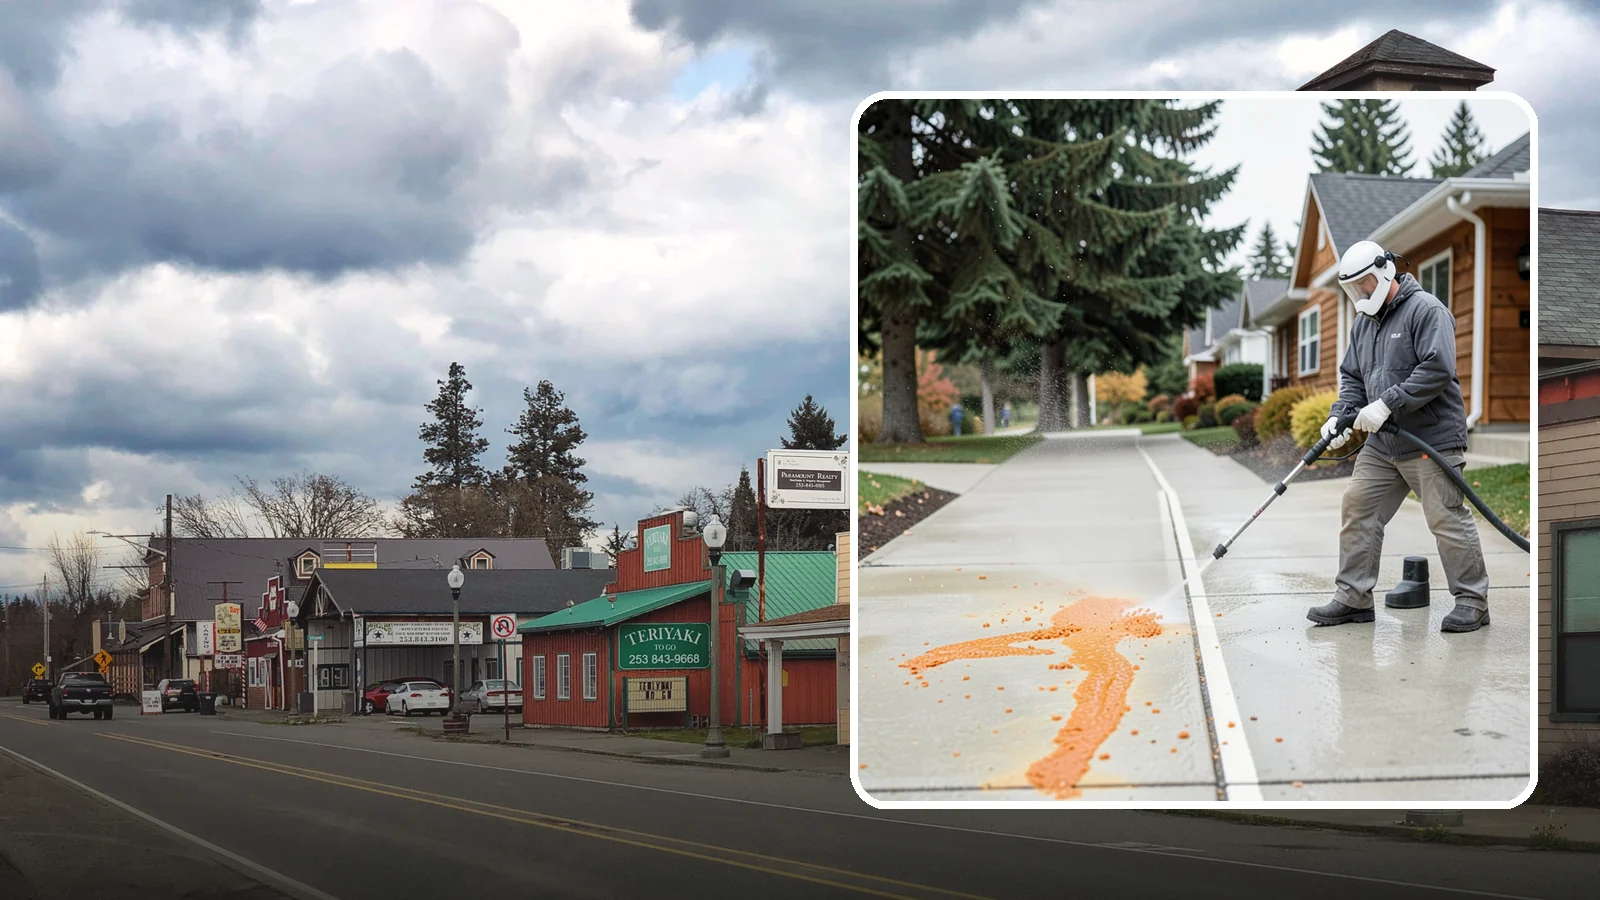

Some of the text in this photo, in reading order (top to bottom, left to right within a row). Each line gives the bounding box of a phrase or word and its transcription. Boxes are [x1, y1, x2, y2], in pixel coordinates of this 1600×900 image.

[781, 471, 839, 480] PARAMOUNT REALTY
[624, 628, 702, 646] TERIYAKI
[629, 654, 700, 664] 253 843-9668
